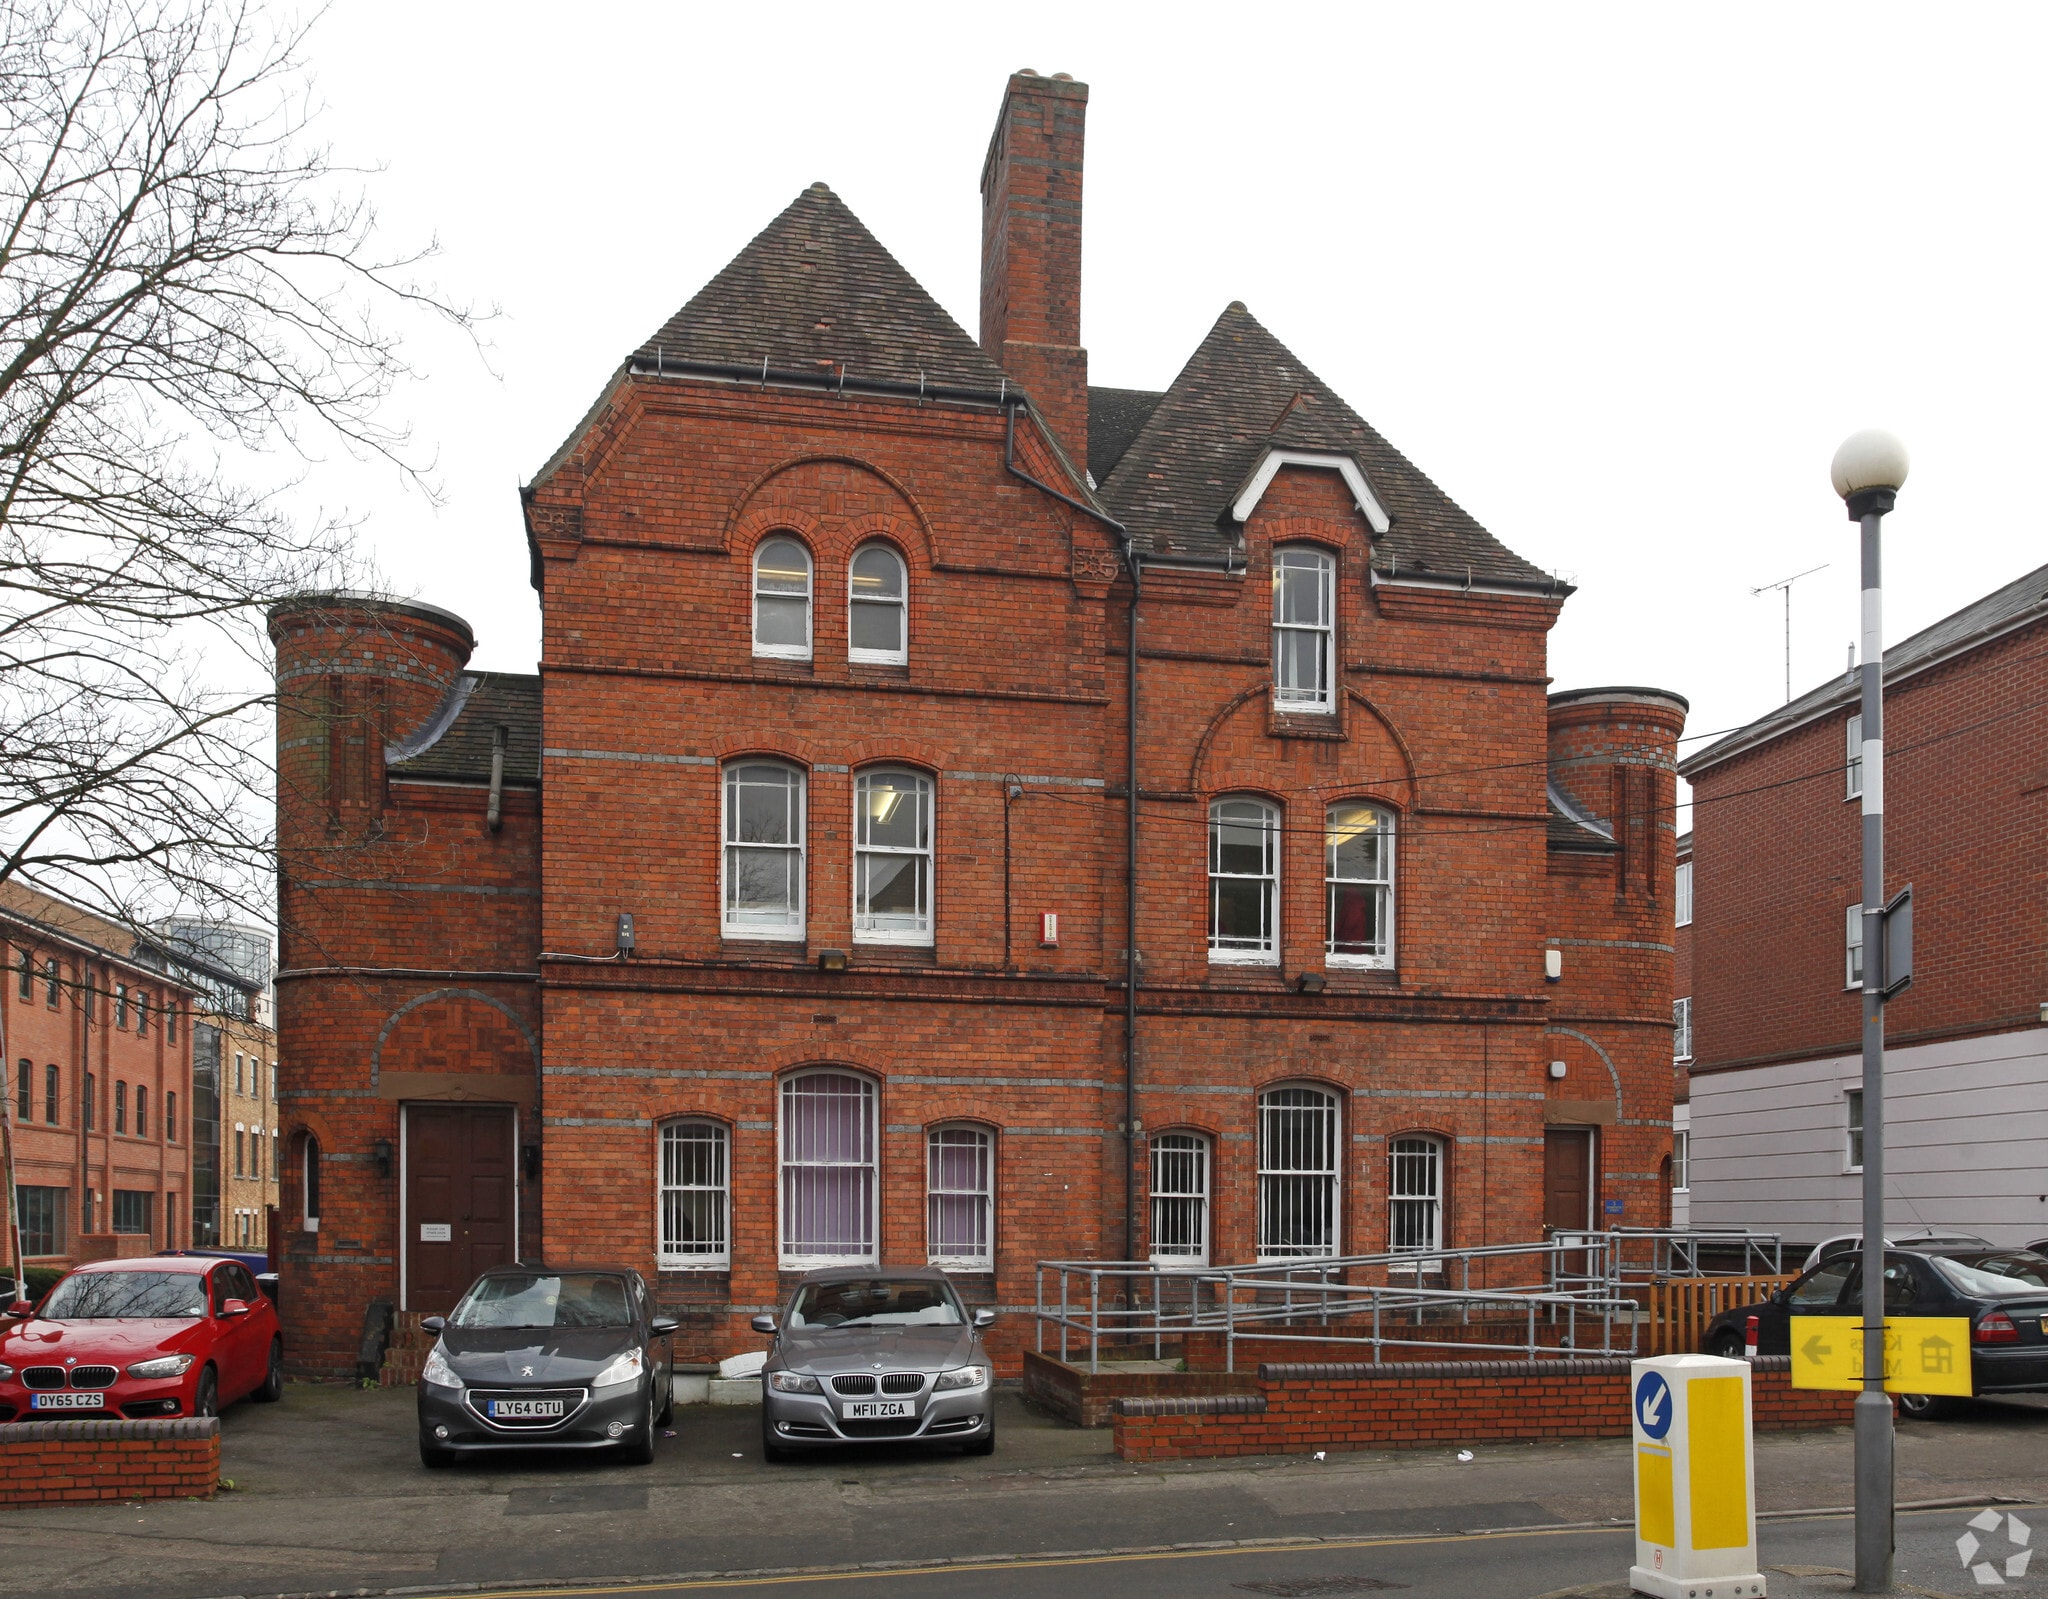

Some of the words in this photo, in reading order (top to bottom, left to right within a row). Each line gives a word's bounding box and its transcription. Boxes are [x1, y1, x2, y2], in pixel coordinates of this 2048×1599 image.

[40, 1395, 73, 1406] OY65
[76, 1394, 101, 1406] CZS
[497, 1402, 531, 1414] LY64
[535, 1402, 560, 1414] GTU
[853, 1404, 876, 1416] MF11
[880, 1403, 905, 1415] ZGA
